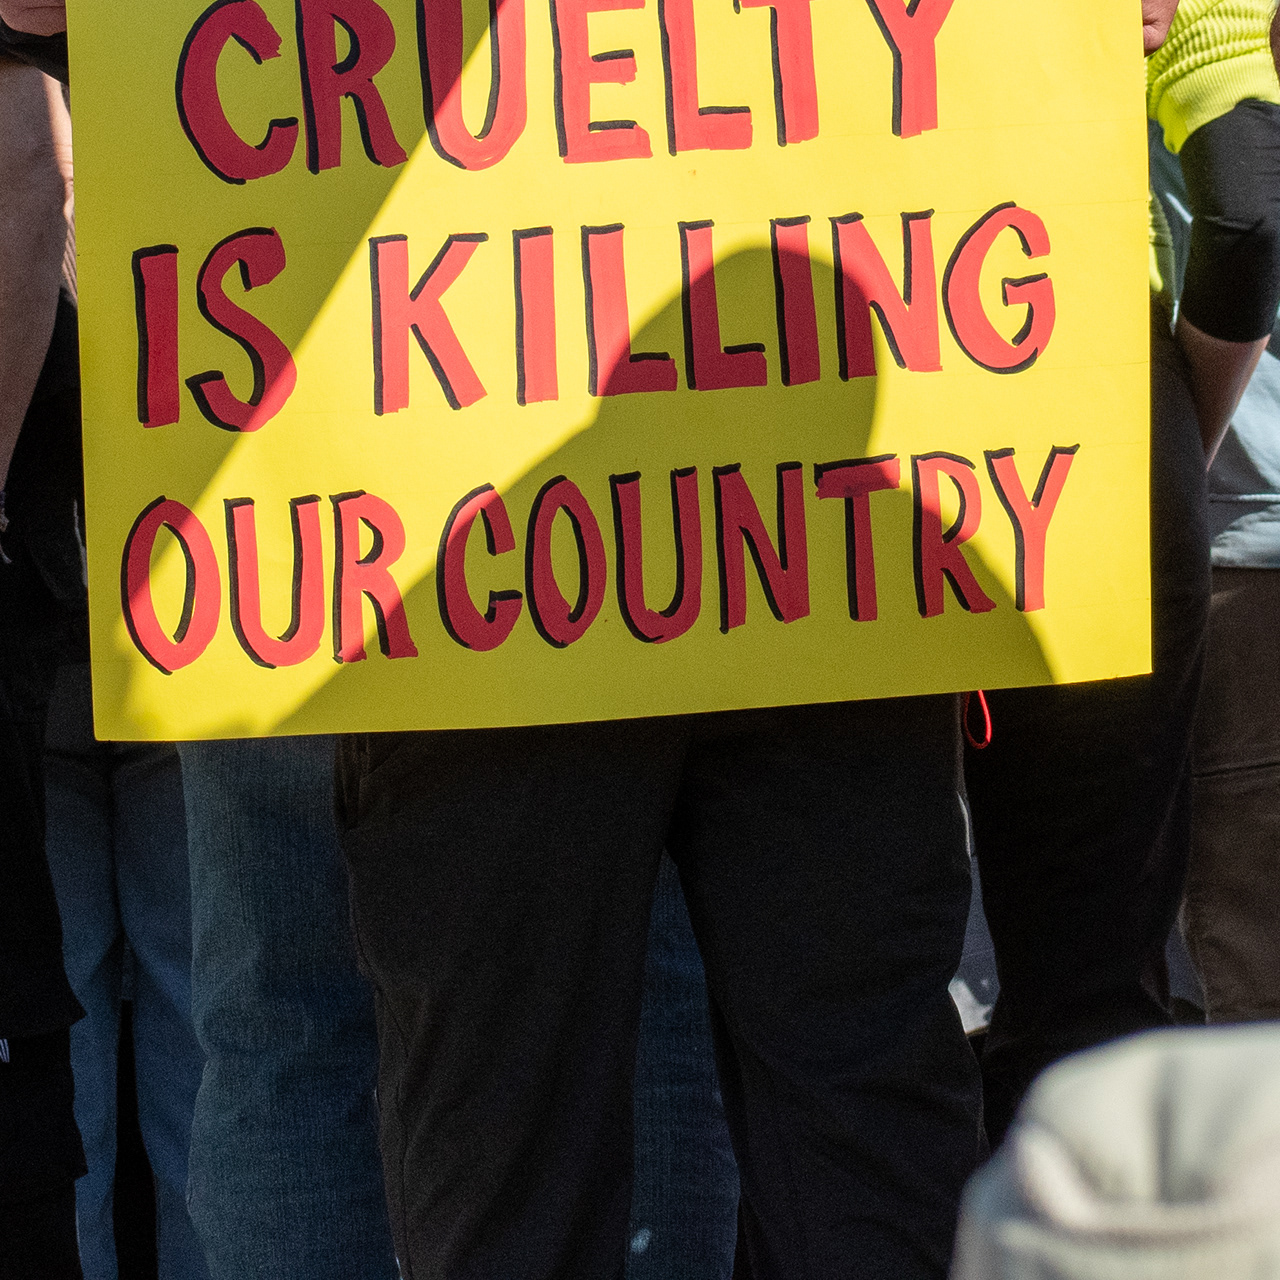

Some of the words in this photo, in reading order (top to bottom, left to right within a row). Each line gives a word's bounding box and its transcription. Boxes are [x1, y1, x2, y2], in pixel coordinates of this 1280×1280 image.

[132, 226, 298, 433] IS
[370, 201, 1057, 417] KILLING
[121, 491, 419, 675] OUR
[436, 443, 1080, 652] COUNTRY
